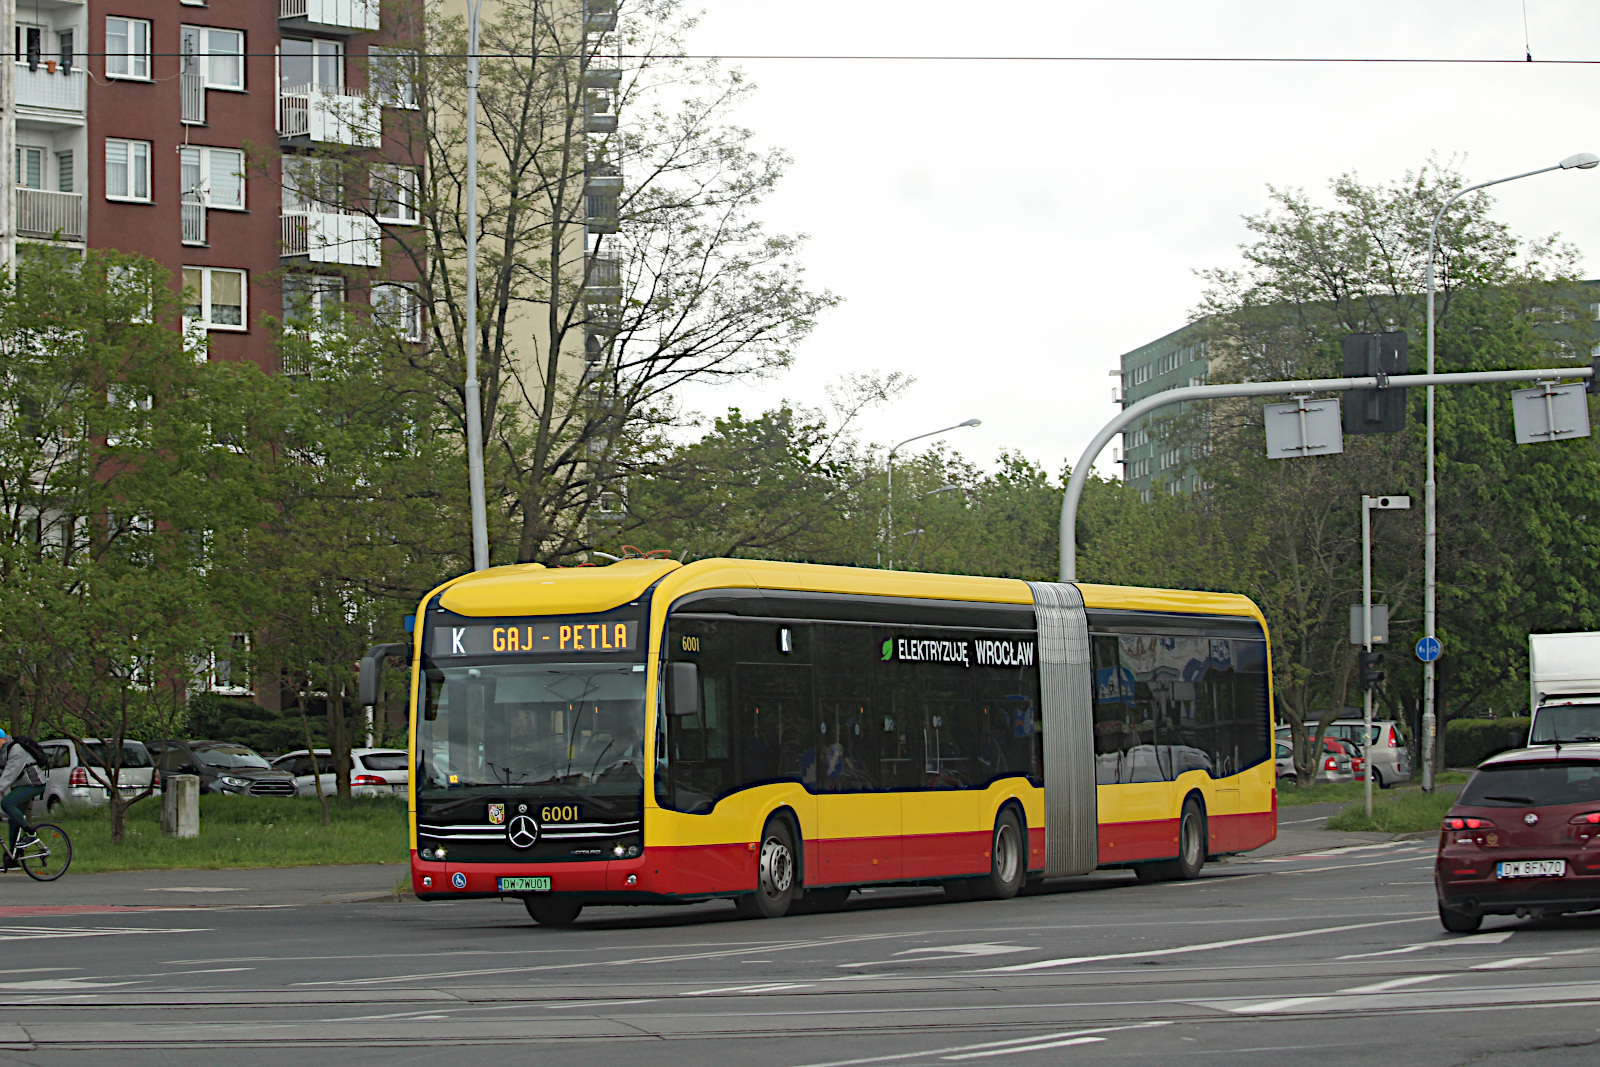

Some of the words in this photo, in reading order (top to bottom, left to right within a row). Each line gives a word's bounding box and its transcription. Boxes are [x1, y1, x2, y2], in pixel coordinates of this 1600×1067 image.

[452, 627, 466, 654] K
[492, 626, 533, 652] GAJ
[559, 623, 627, 650] PĘTLA
[682, 636, 700, 652] 6001
[781, 628, 790, 652] K
[898, 638, 969, 667] ELEKTRYZUJĘ
[975, 640, 1034, 666] WROCŁAW
[541, 805, 578, 821] 6001
[1504, 862, 1520, 875] DW
[1524, 861, 1562, 874] 8FN70
[503, 878, 516, 889] DW
[519, 878, 547, 889] 7WU01
